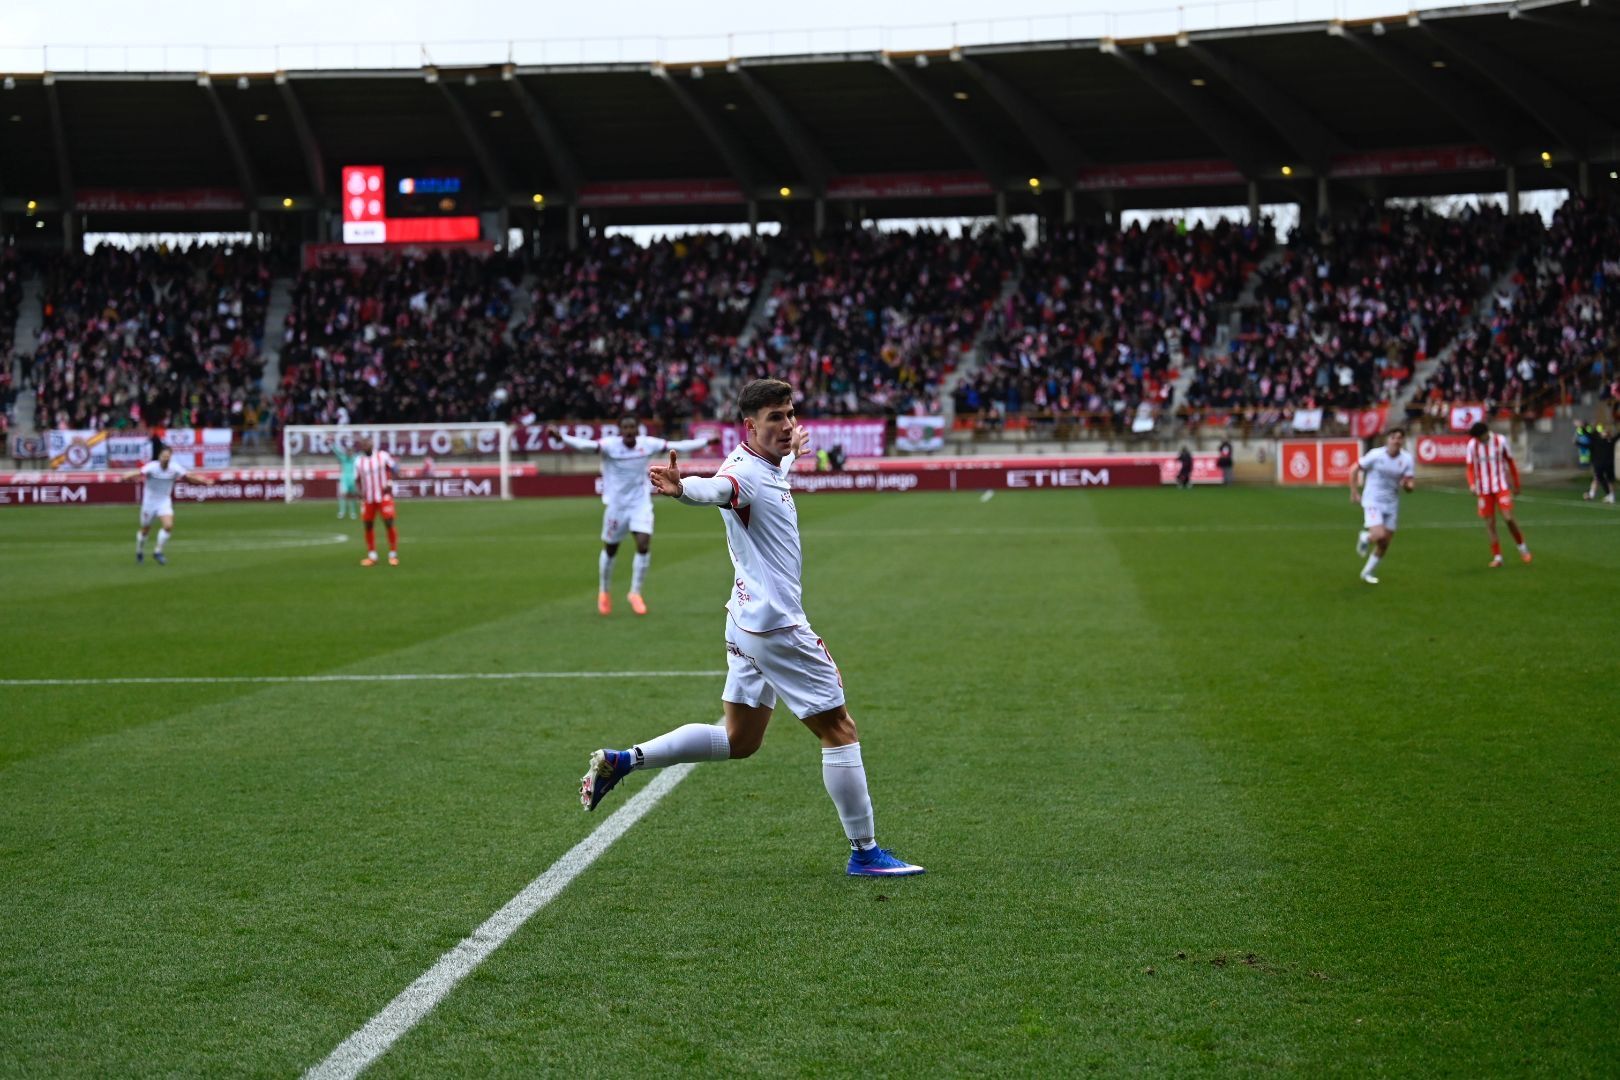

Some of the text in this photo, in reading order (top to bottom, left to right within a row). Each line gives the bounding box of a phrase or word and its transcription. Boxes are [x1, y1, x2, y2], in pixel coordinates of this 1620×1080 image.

[476, 424, 648, 454] CZURR
[787, 472, 918, 492] Elegancia en juego
[1006, 469, 1110, 487] ETIEM
[175, 482, 242, 501] Elegancia
[244, 484, 264, 498] en
[391, 479, 492, 497] ETIEM
